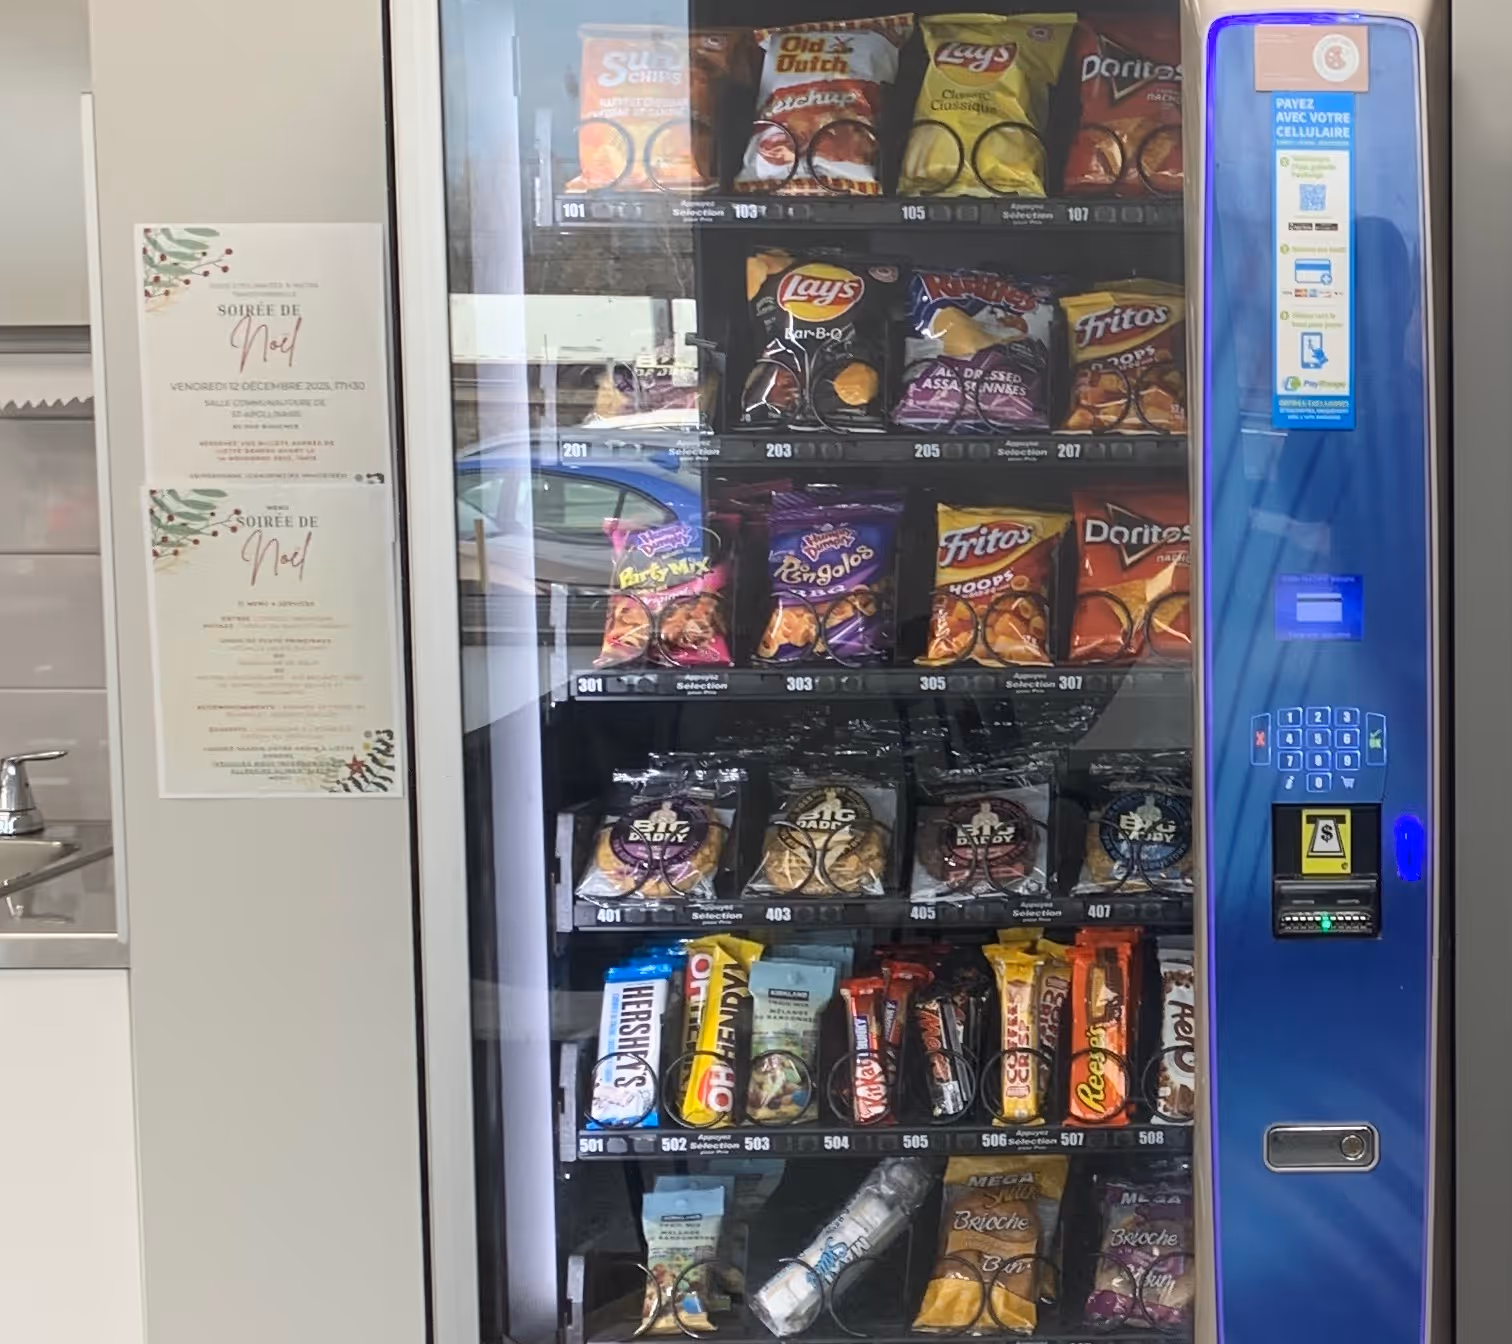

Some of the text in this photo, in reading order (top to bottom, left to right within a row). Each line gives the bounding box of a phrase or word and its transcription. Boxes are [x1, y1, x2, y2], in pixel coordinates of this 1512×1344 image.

[781, 36, 825, 53] Old
[776, 54, 849, 73] Dutch
[1081, 54, 1184, 82] Doritos
[1275, 98, 1315, 110] PAYEZ
[1275, 112, 1350, 124] AVEC VOTRE
[1275, 126, 1350, 138] CELLULAIRE
[563, 203, 585, 218] 101
[734, 204, 759, 218] 103
[902, 206, 925, 220] 105
[1067, 208, 1088, 221] 107
[781, 275, 860, 306] Lay's
[217, 301, 301, 317] SOIRÉE DE
[1074, 305, 1169, 348] Fritos
[229, 314, 302, 373] Noël
[963, 367, 1022, 384] DRSSED
[564, 443, 587, 457] 201
[766, 443, 792, 458] 203
[914, 443, 940, 458] 205
[1057, 444, 1081, 458] 207
[236, 513, 319, 528] SOIRÉE DE
[1085, 518, 1191, 545] Doritos
[939, 524, 1033, 567] Fritos
[241, 529, 313, 586] Noël
[773, 545, 874, 586] Ringolos
[949, 569, 1015, 595] HOOPS
[578, 677, 602, 692] 301
[787, 677, 813, 692] 303
[920, 676, 946, 690] 305
[1059, 676, 1083, 690] 307
[633, 820, 690, 833] BIG
[597, 909, 621, 923] 401
[765, 908, 792, 922] 403
[910, 907, 937, 920] 405
[1087, 905, 1111, 919] 407
[614, 984, 655, 1089] HERSHEY'S
[1076, 1024, 1106, 1114] Reese's
[707, 1064, 736, 1114] OH
[580, 1139, 603, 1153] 501
[661, 1138, 687, 1152] 502
[744, 1137, 770, 1151] 503
[824, 1136, 849, 1150] 504
[903, 1135, 929, 1149] 505
[982, 1134, 1007, 1147] 506
[1061, 1133, 1084, 1146] 507
[1139, 1132, 1164, 1145] 508
[968, 1172, 1034, 1187] MEGA
[953, 1210, 1029, 1232] Brioche
[1110, 1228, 1178, 1247] Brioche
